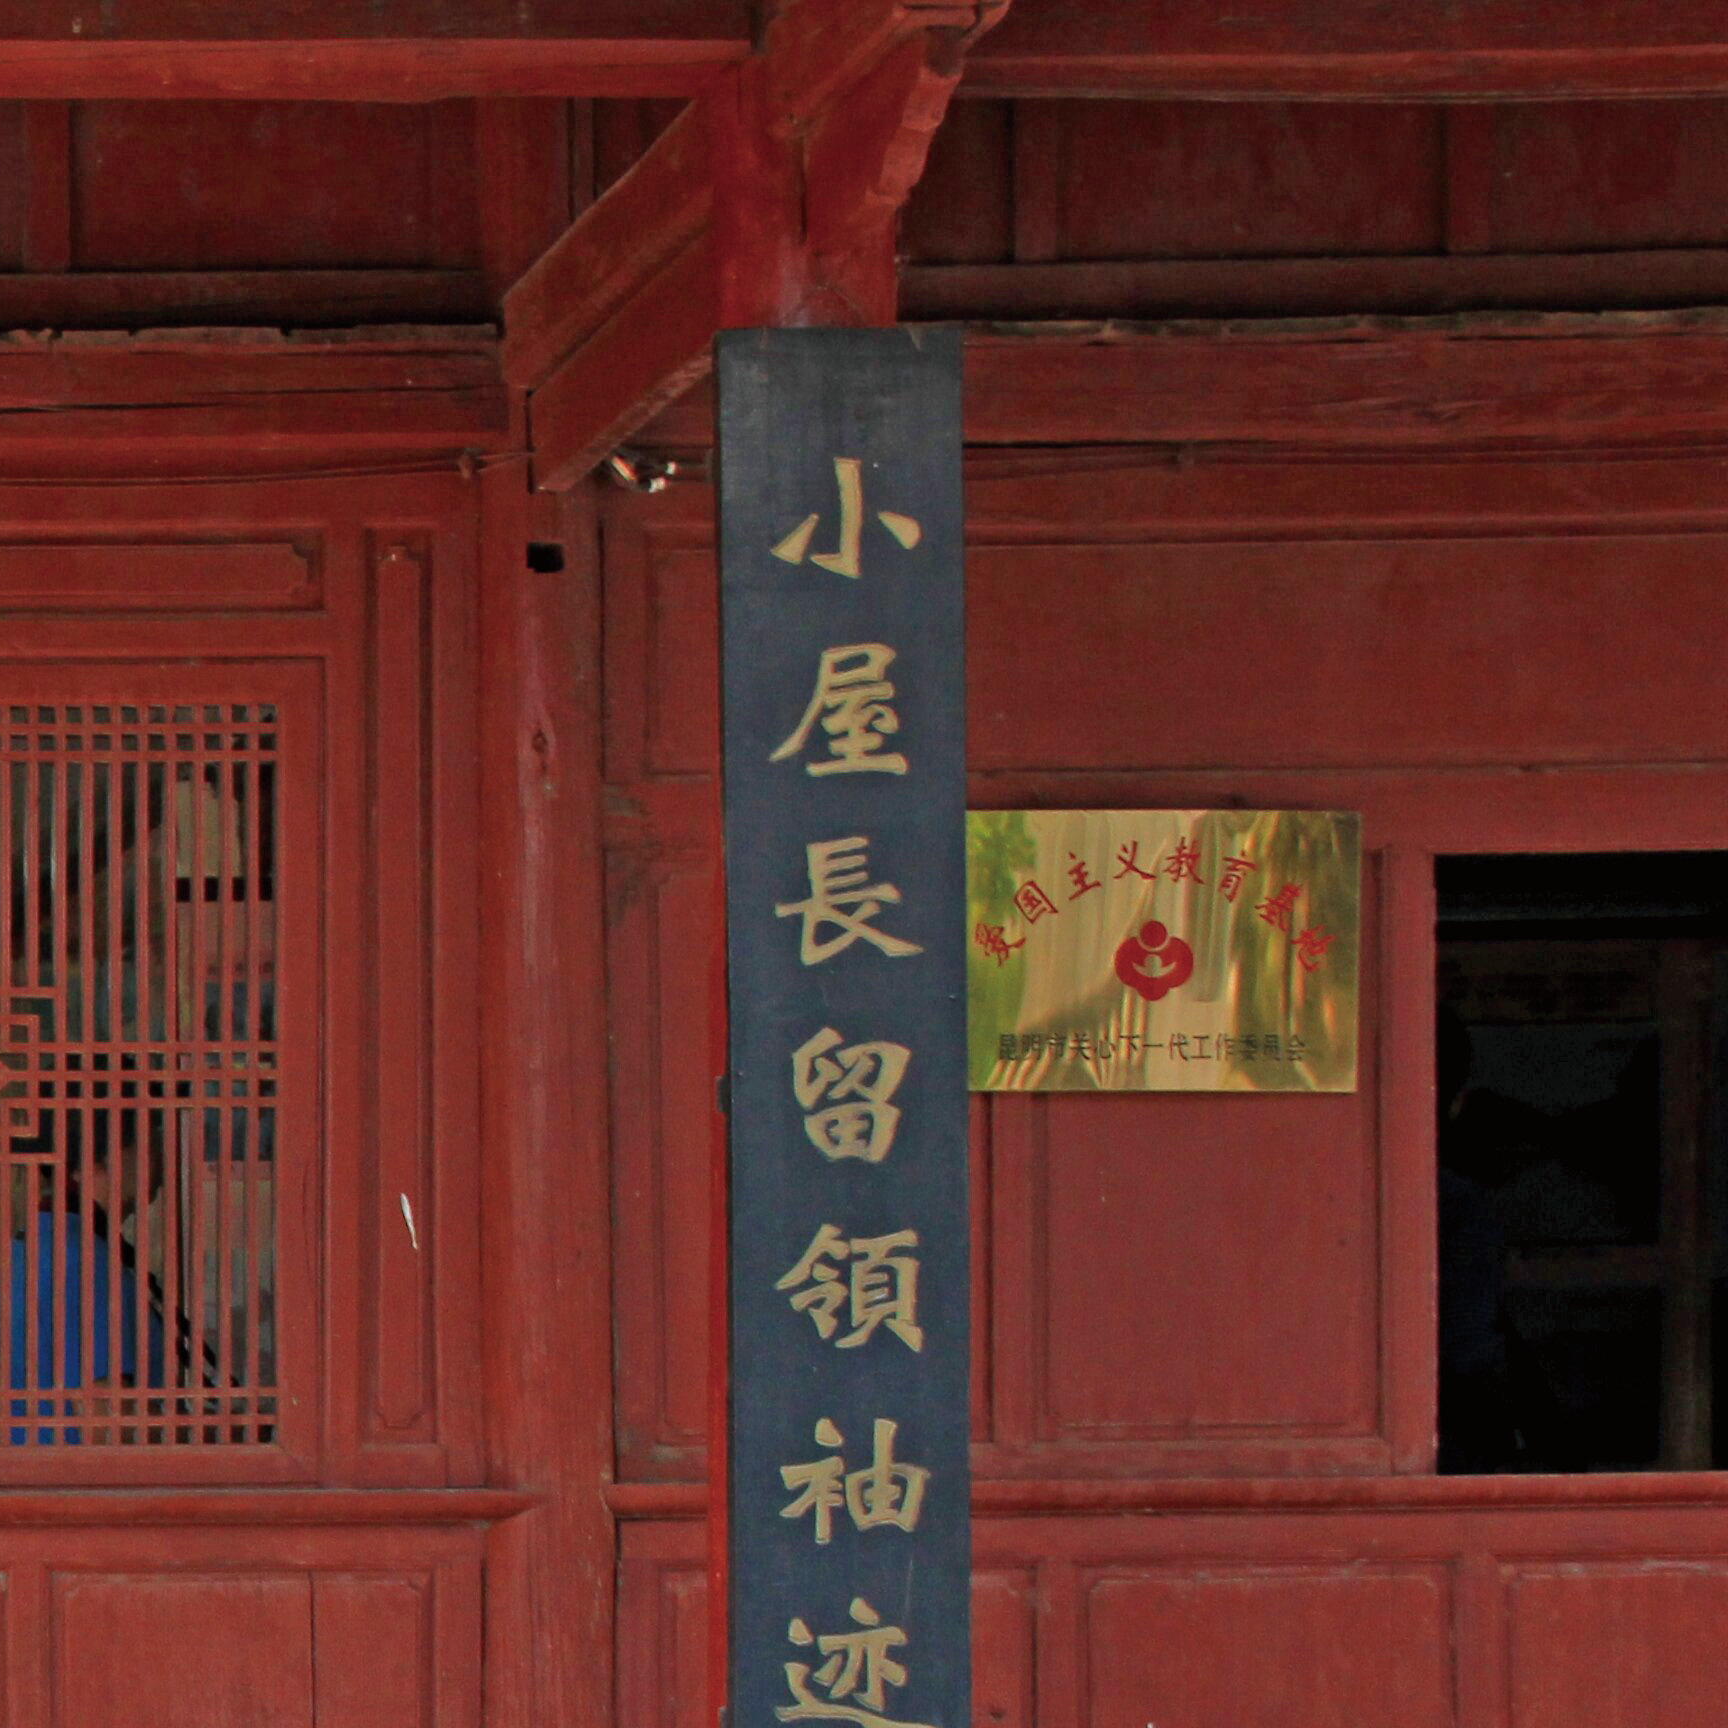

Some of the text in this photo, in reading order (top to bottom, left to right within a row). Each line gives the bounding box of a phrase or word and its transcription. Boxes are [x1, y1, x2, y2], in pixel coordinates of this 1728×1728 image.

[998, 1032, 1307, 1062] 昆明市关心下一代工作委员会
